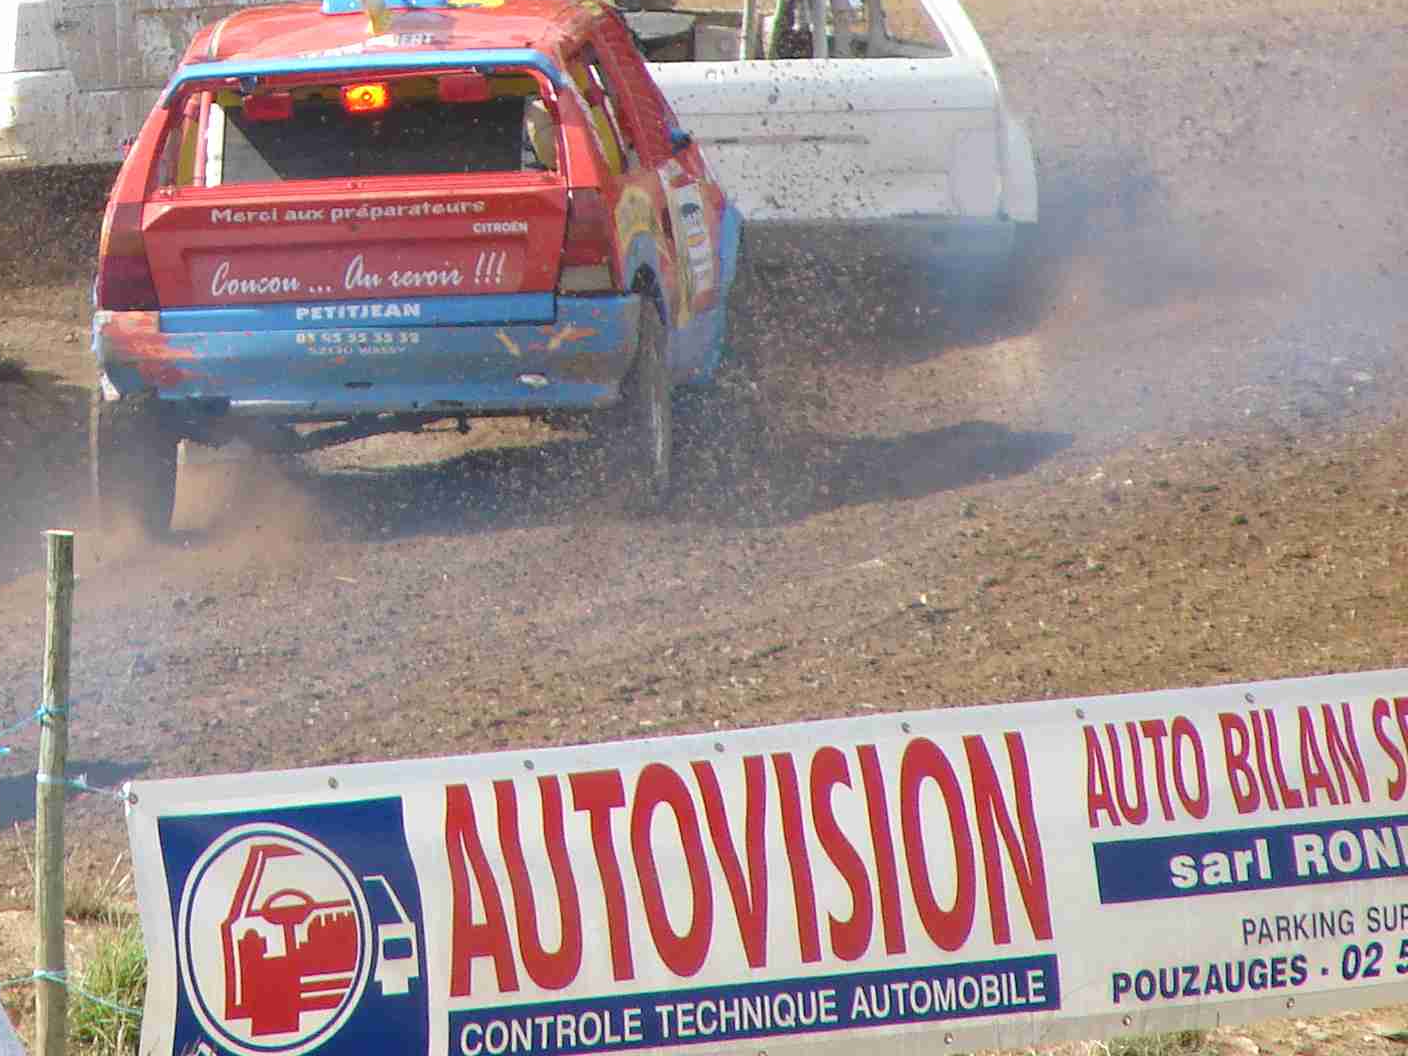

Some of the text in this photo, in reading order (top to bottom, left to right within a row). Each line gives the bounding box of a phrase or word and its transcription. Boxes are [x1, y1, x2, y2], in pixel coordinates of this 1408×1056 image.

[211, 199, 486, 224] Merci aux préparateurs
[211, 260, 300, 297] Coucou
[344, 253, 381, 290] Au
[388, 262, 463, 289] revoir
[473, 250, 507, 286] !!!
[296, 303, 420, 320] PETITJEAN
[1083, 715, 1210, 828] AUTO
[1217, 701, 1371, 815] BILAN
[445, 731, 1054, 998] AUTOVISION
[1168, 838, 1273, 889] sarl
[1242, 909, 1355, 945] PARKING
[1111, 954, 1308, 1004] POUZAUGES
[1341, 941, 1384, 981] 02
[459, 969, 1046, 1055] CONTROLE TECHNIQUE AUTOMOBILE
